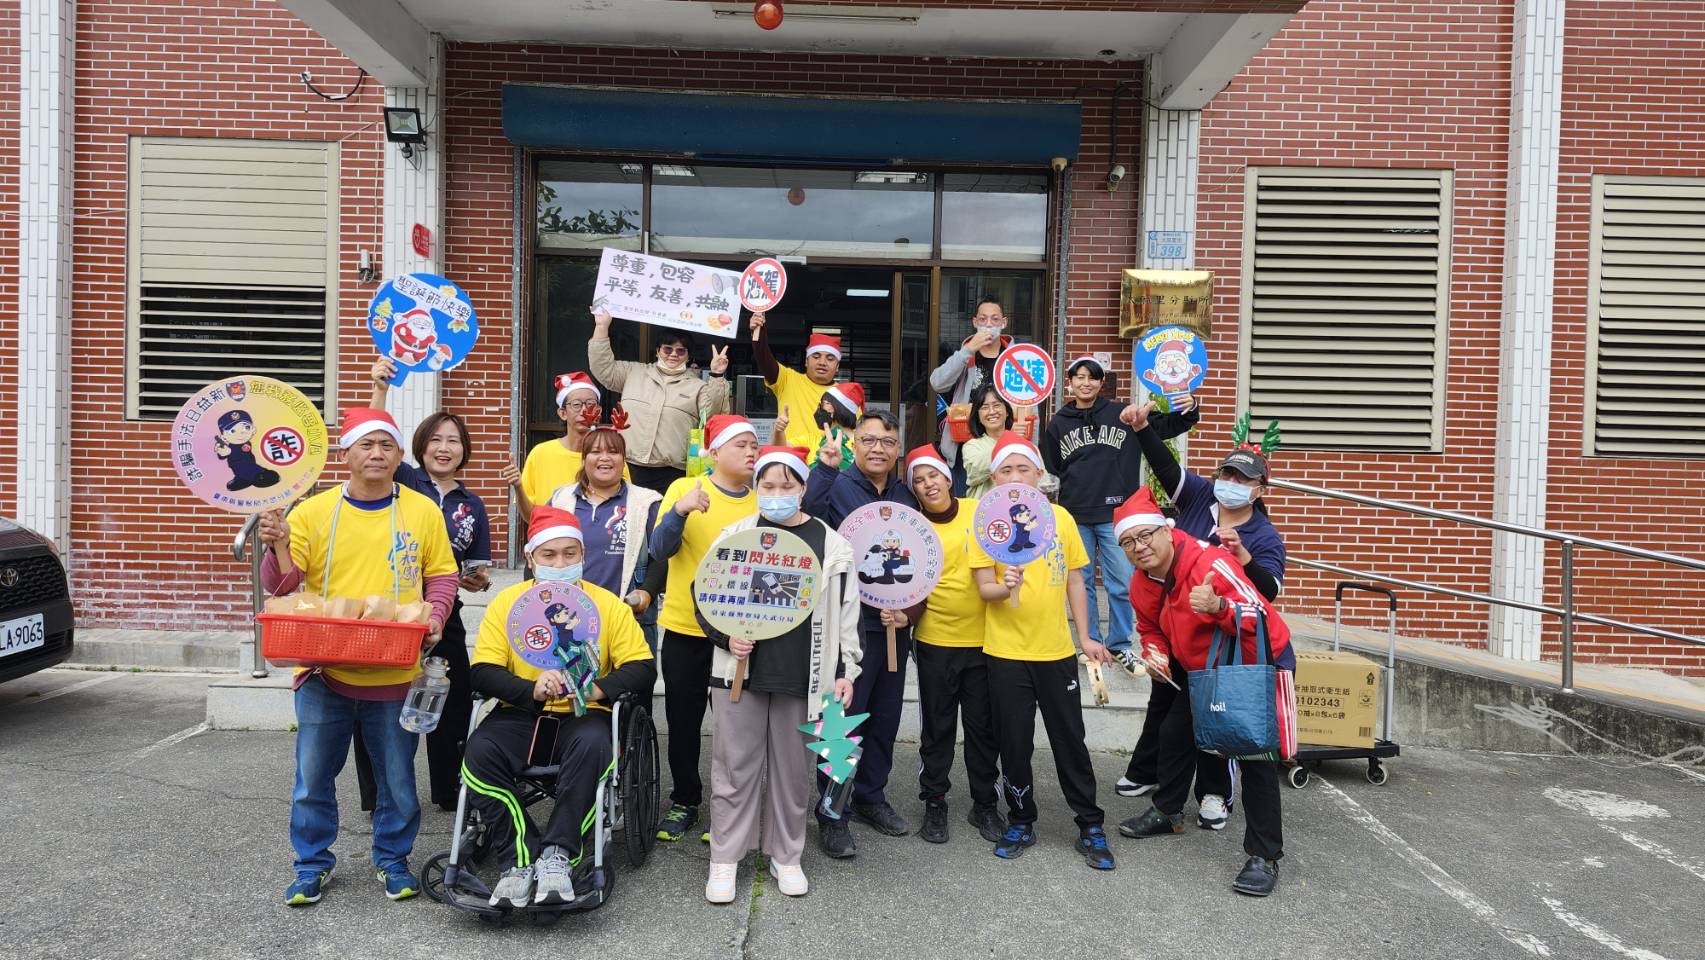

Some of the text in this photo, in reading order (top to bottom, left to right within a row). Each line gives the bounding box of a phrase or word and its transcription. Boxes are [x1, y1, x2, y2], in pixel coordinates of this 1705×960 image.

[1160, 245, 1183, 257] 398
[395, 275, 471, 321] 聖誕節快樂
[1003, 358, 1046, 392] 超速
[177, 386, 227, 482] 詐騙手法日益新
[267, 433, 298, 461] 詐
[1059, 424, 1127, 461] NIKE AIR
[715, 547, 814, 570] 看到閃光紅燈
[698, 591, 746, 605] 請停車再開
[811, 618, 822, 694] BEAUTIFUL
[1210, 701, 1226, 712] hoi!
